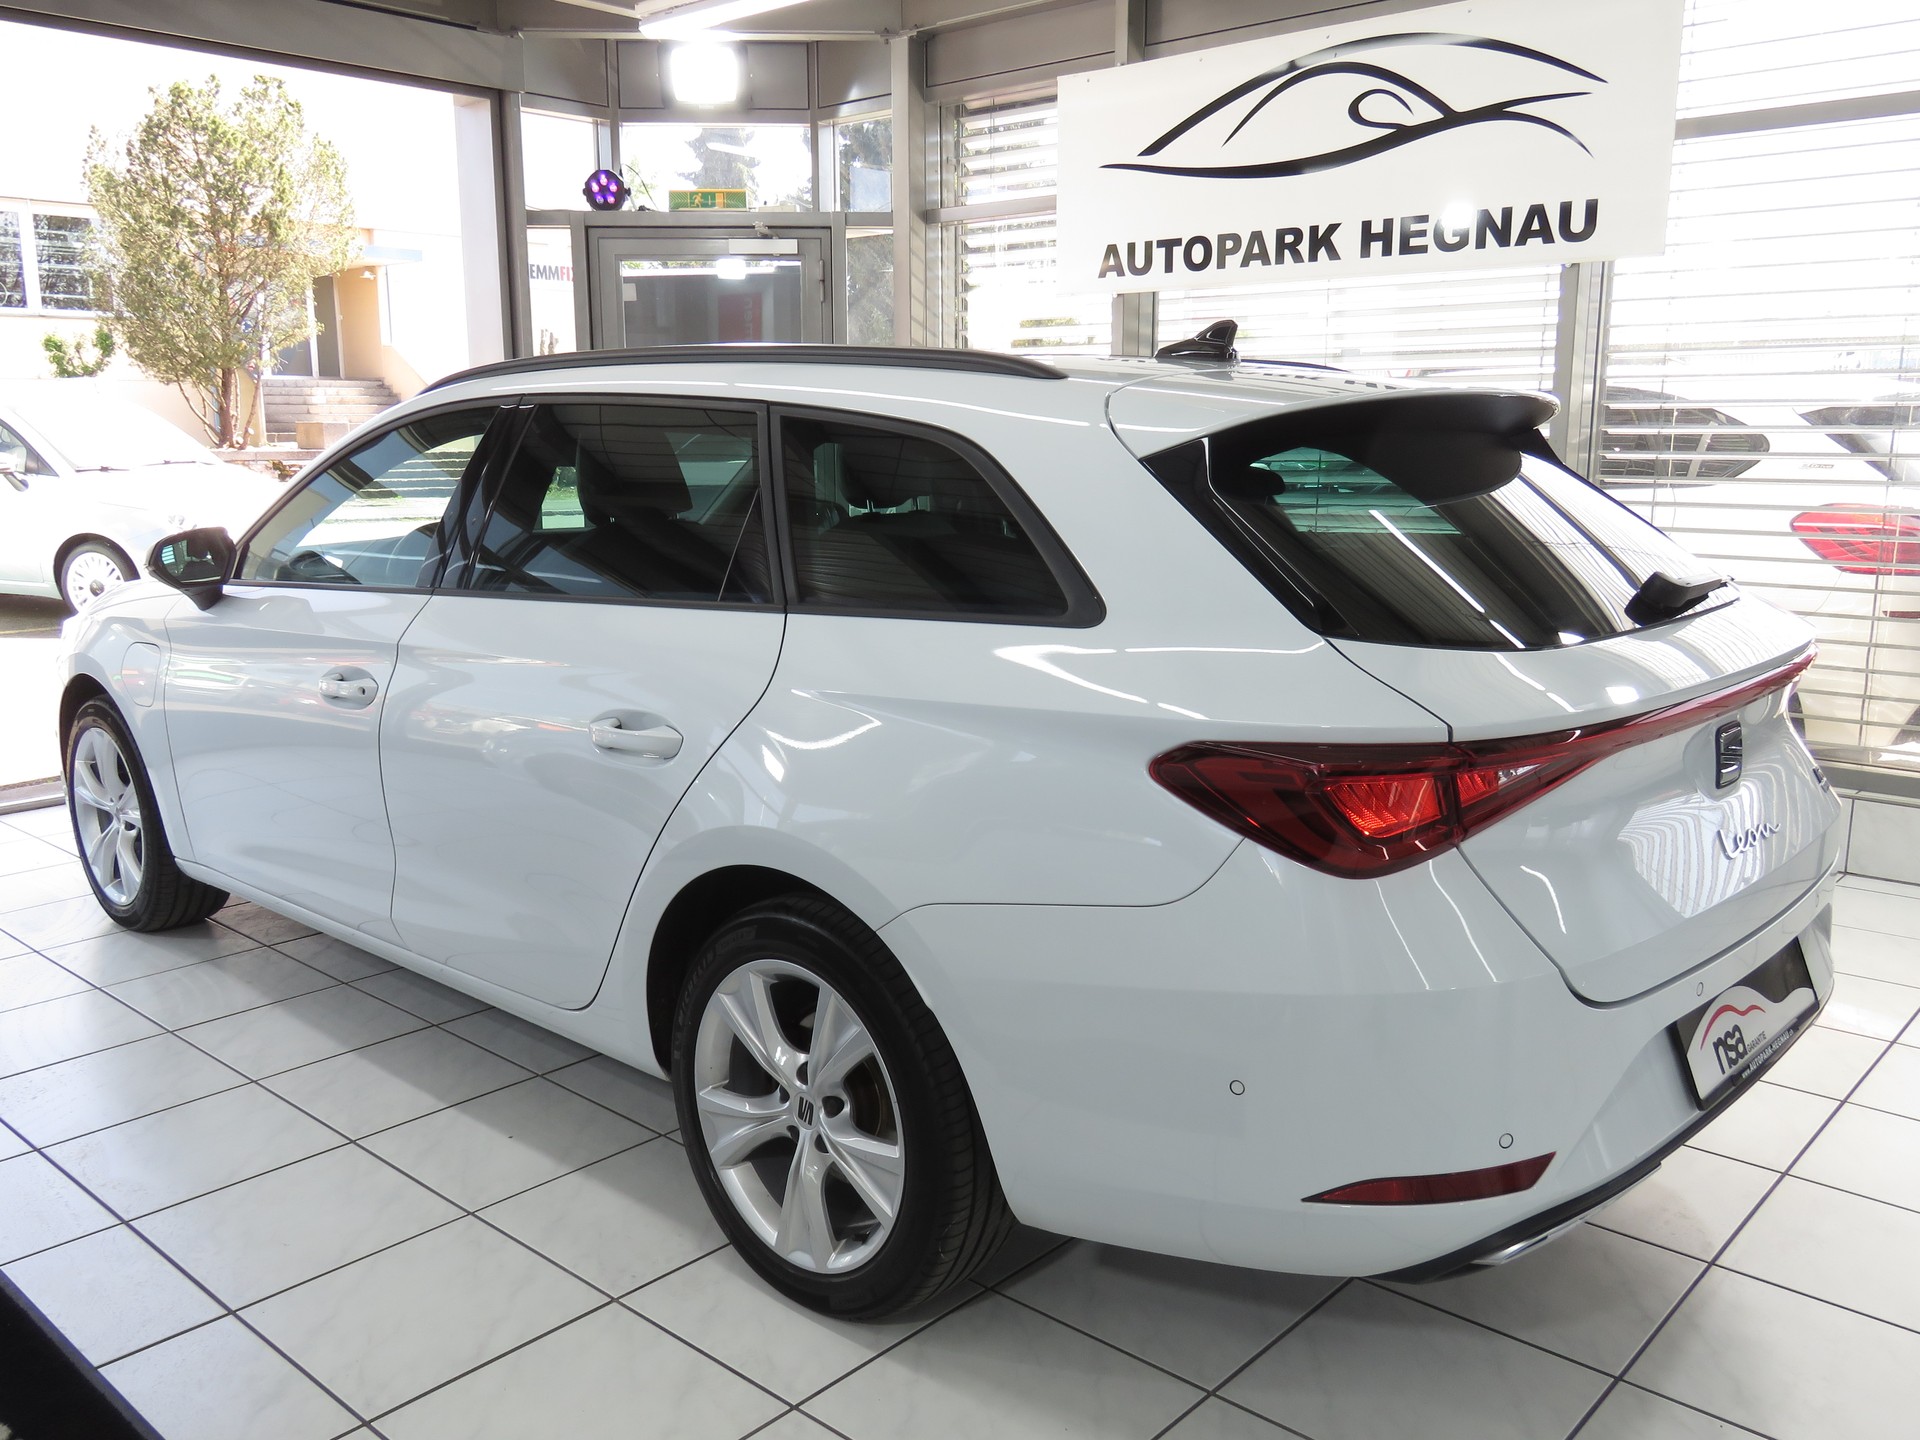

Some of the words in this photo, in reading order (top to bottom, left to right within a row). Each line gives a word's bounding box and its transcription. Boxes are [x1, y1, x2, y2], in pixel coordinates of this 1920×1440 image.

[1098, 222, 1342, 278] AUTOPARK
[1360, 198, 1599, 259] HEGNAU
[1717, 823, 1781, 861] Leon
[1713, 1024, 1748, 1075] nsa
